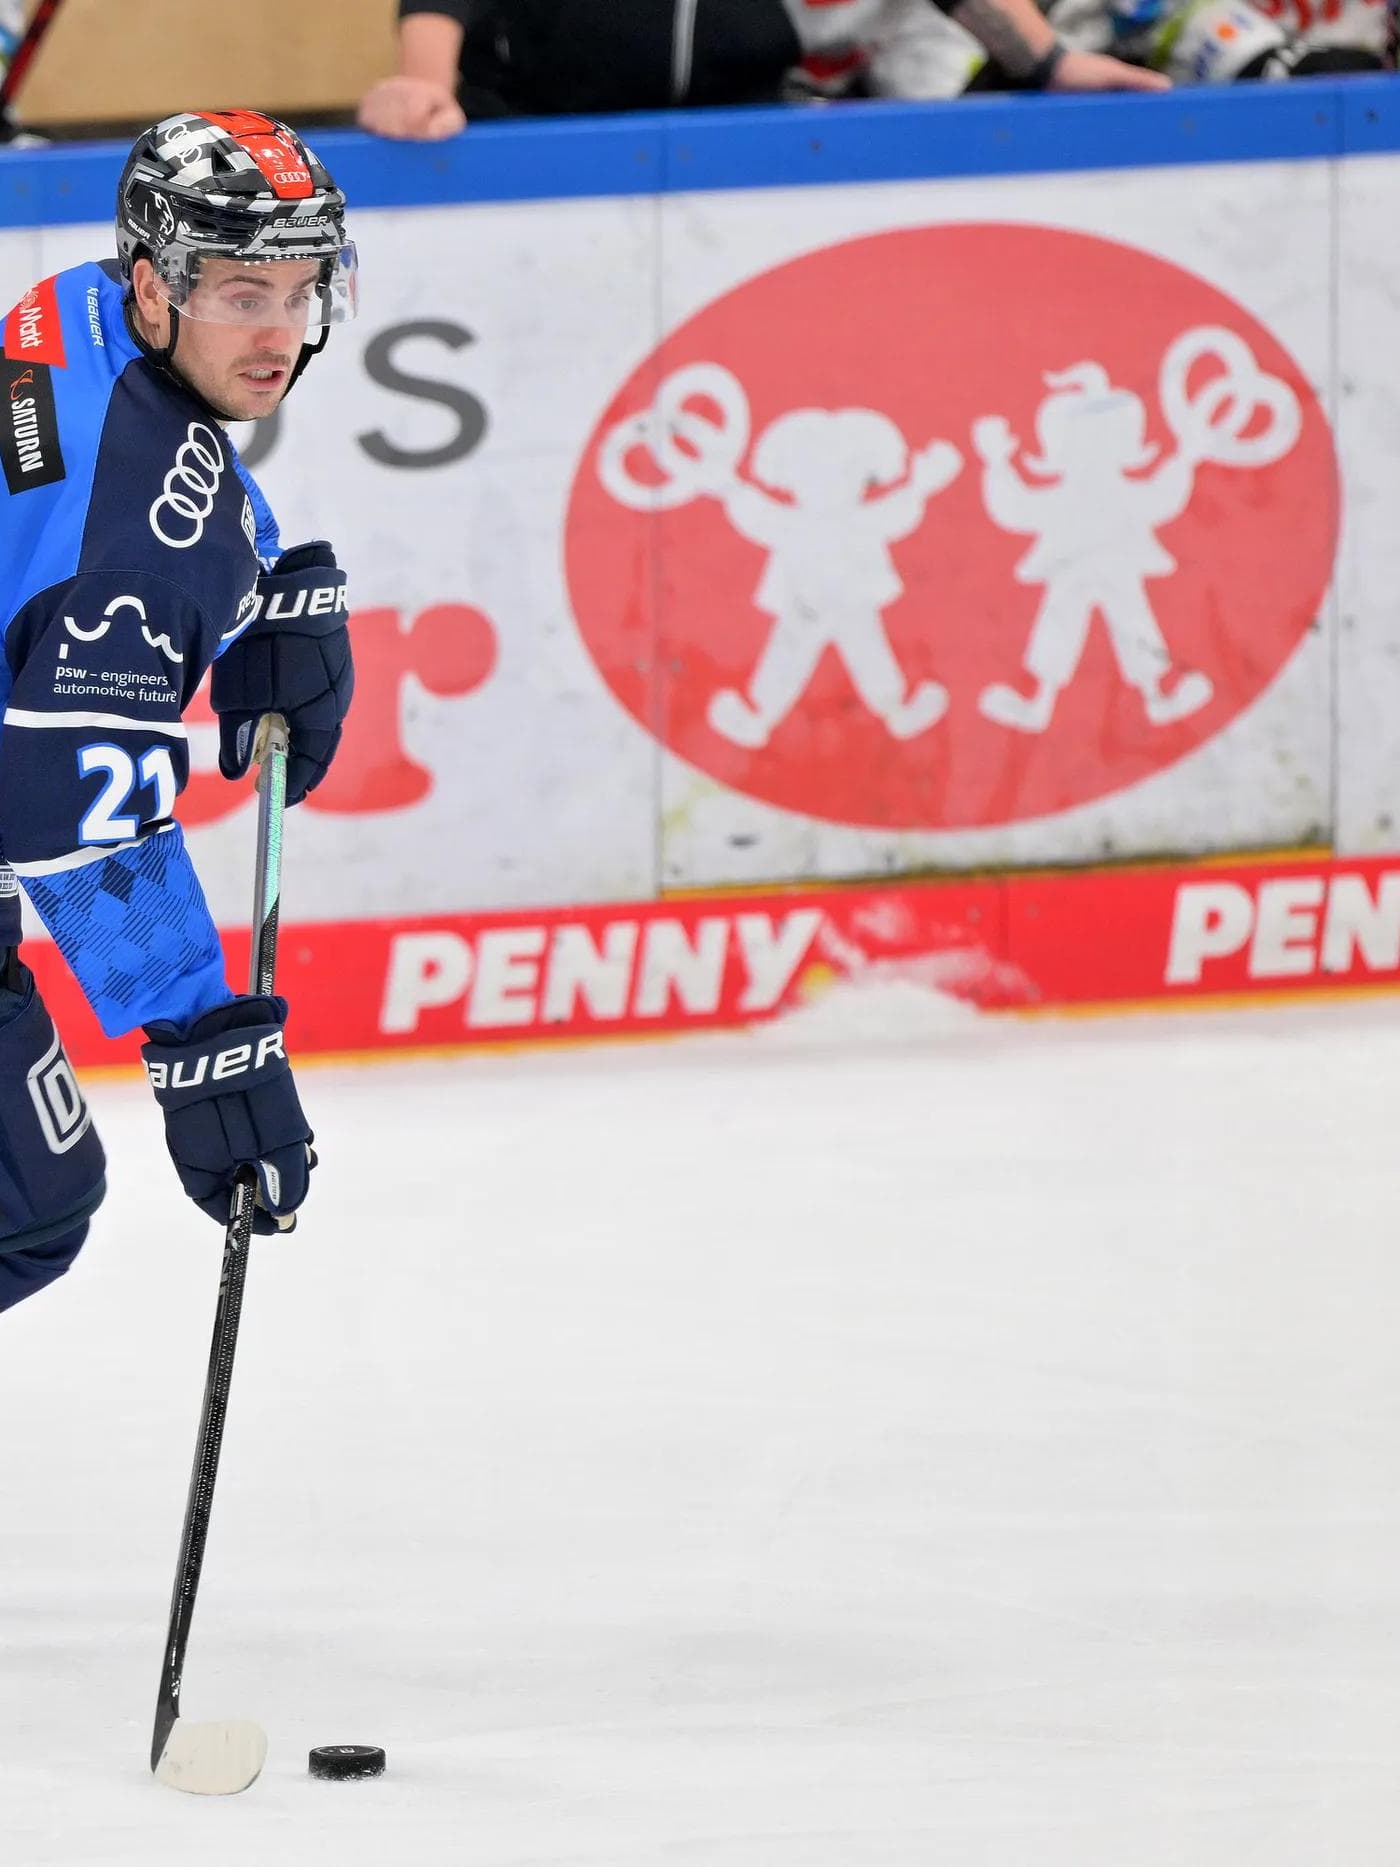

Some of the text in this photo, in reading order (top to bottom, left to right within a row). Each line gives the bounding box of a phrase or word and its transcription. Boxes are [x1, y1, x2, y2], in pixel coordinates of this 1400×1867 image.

[11, 397, 44, 474] SATURN
[53, 683, 177, 703] automotive future
[55, 666, 169, 687] psw engineers
[78, 743, 177, 845] 21
[141, 1031, 286, 1089] AUER
